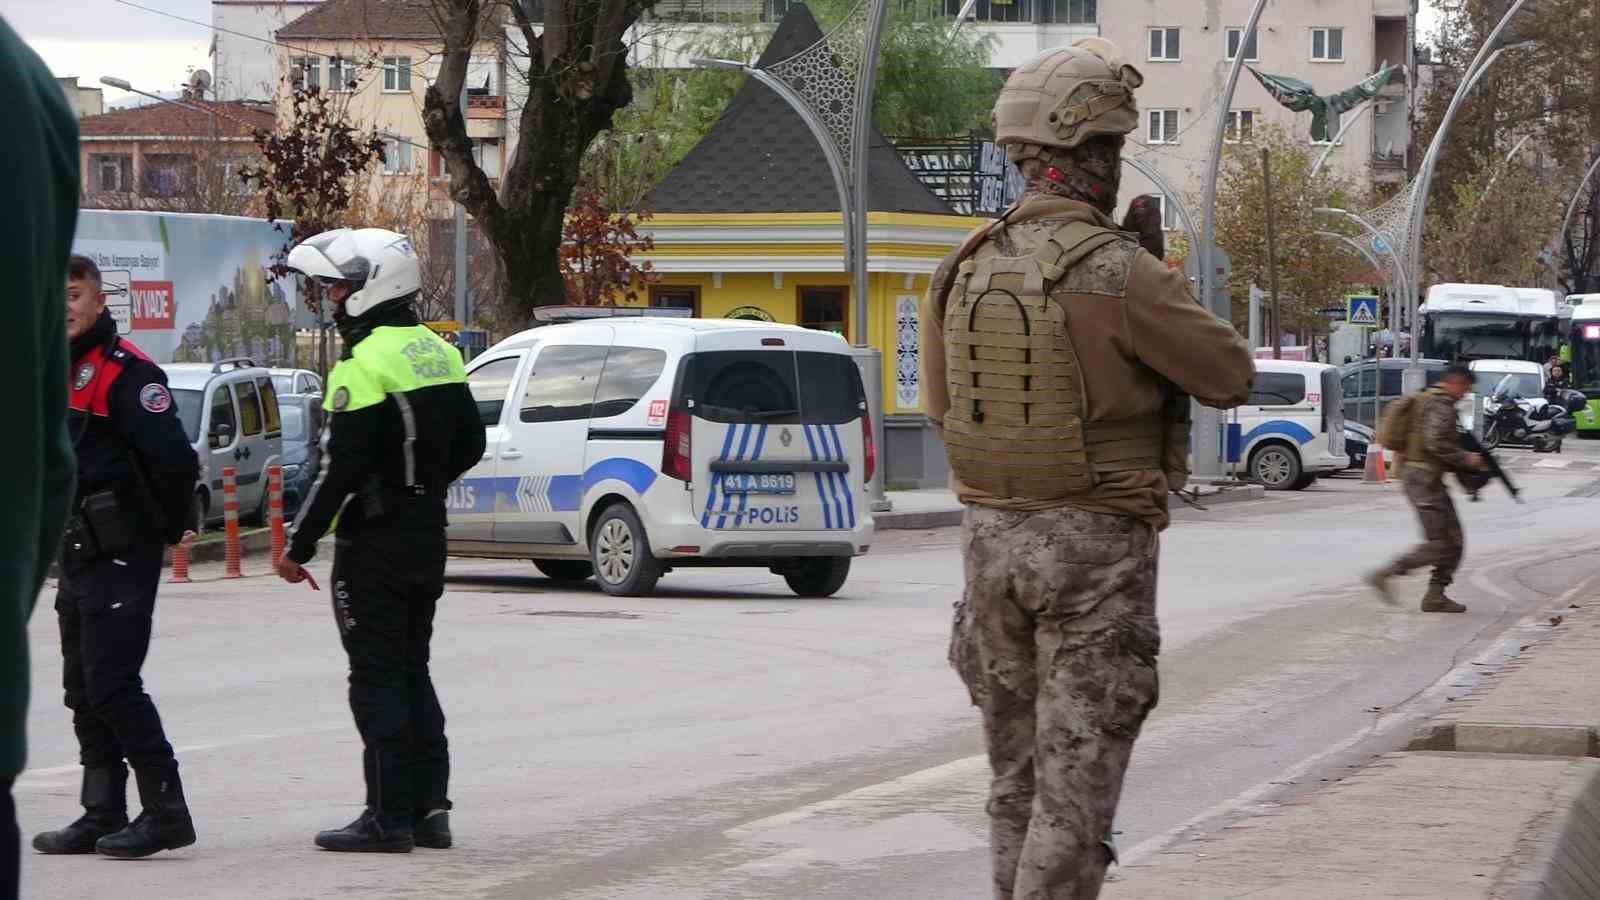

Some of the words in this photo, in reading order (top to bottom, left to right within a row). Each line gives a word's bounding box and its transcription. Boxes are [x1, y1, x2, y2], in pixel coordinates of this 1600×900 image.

[725, 474, 742, 489] 41
[747, 474, 758, 489] A
[760, 474, 795, 489] 8619
